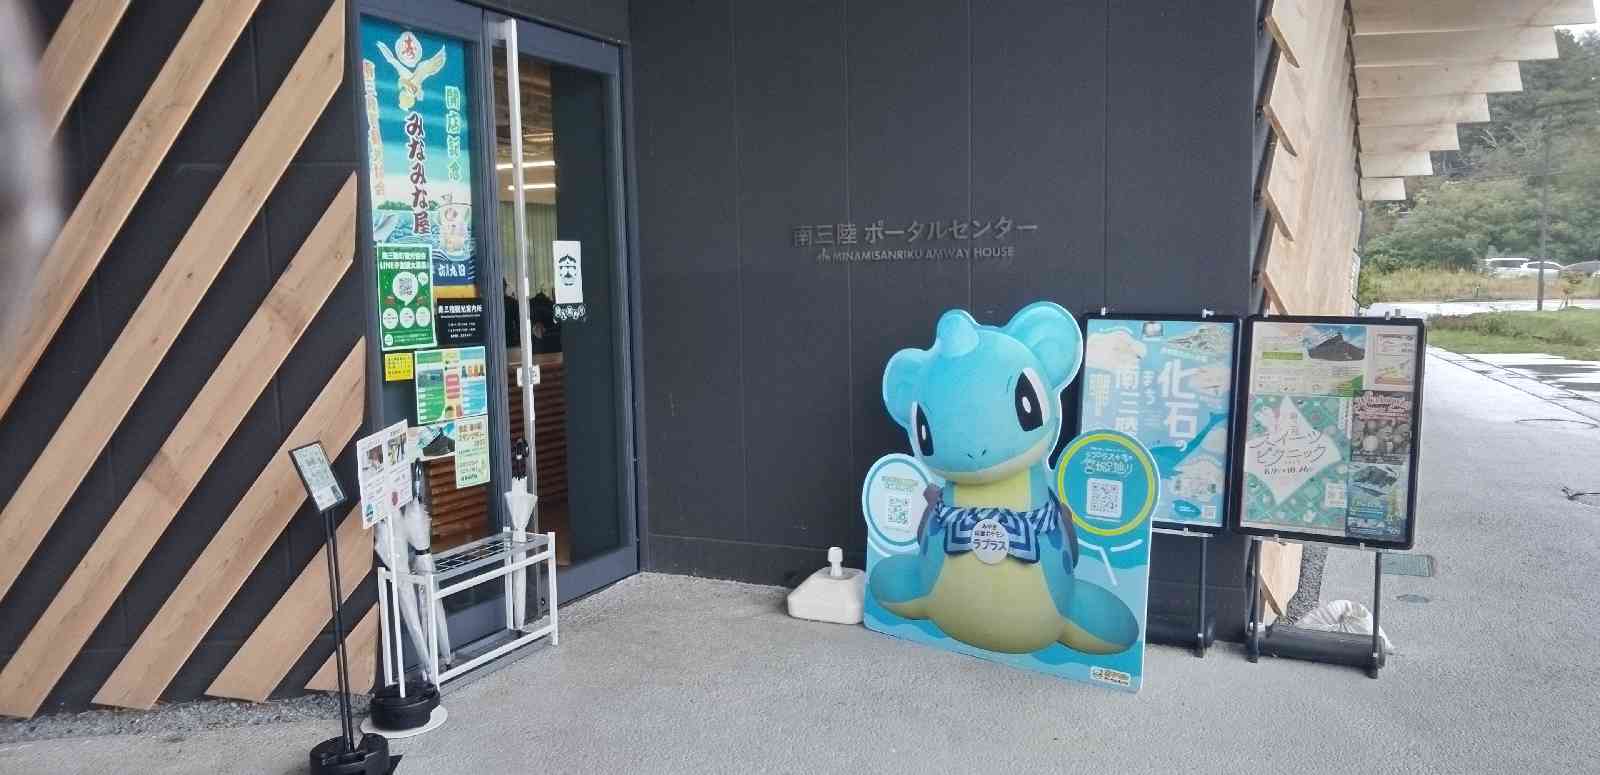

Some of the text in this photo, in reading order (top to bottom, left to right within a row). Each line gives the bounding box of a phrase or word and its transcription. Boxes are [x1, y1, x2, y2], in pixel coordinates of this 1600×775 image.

[445, 86, 462, 182] 開店記念
[405, 112, 432, 235] みなみな屋
[794, 216, 1038, 247] 南三陸 ポータルセンター
[833, 249, 921, 263] MINAMISANRIKU
[925, 248, 969, 259] AMWAY
[974, 246, 1015, 257] HOUSE
[1249, 430, 1323, 449] スイーツ
[1256, 445, 1326, 467] ピクニック
[973, 539, 1008, 551] ラプラス
